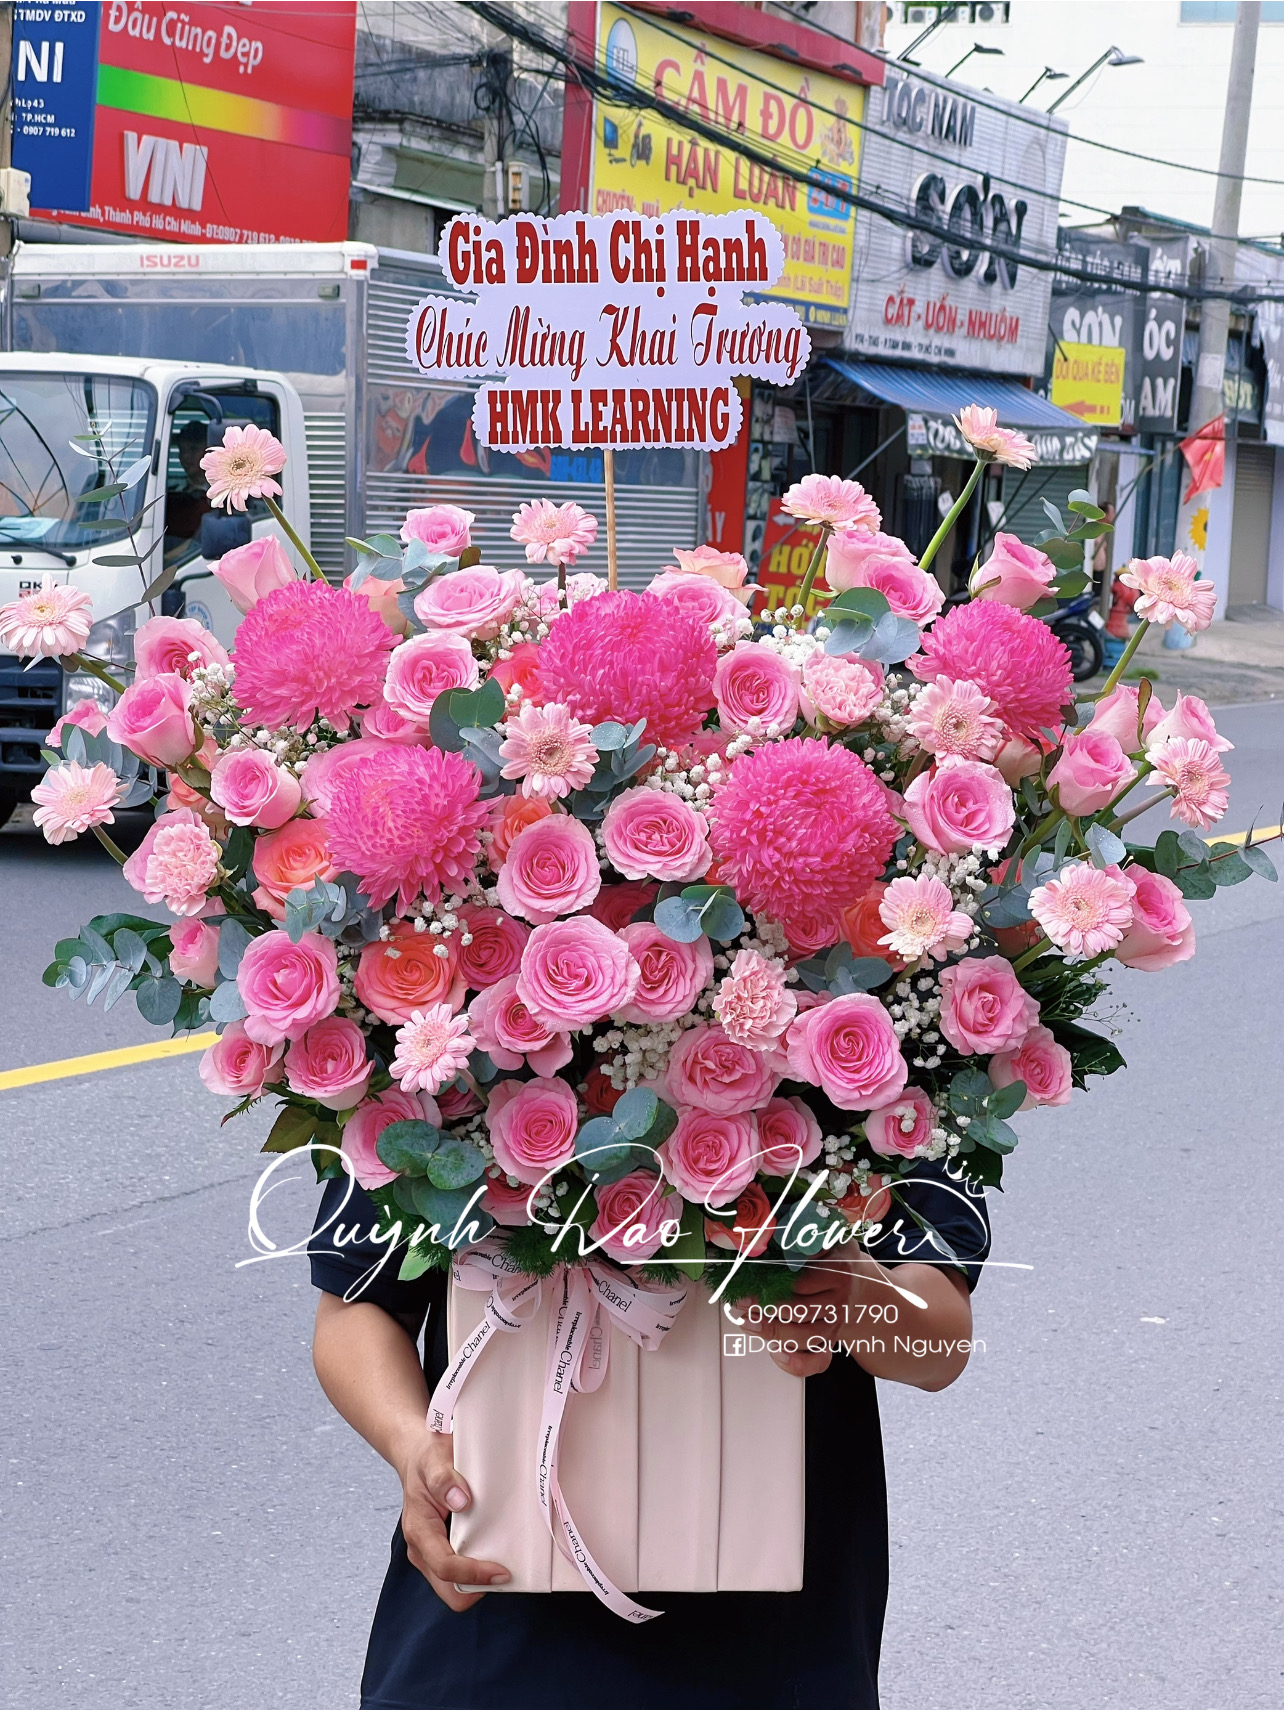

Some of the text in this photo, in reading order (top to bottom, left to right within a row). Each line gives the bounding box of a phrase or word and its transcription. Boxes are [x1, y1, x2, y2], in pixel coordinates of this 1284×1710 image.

[161, 11, 217, 64] Cũng
[220, 25, 263, 74] Đẹp
[760, 76, 815, 150] ĐỒ
[928, 90, 976, 147] NAM
[123, 130, 208, 211] VINI
[104, 205, 132, 225] Thành
[133, 210, 151, 228] Phố
[905, 172, 1028, 290] SƠN
[140, 254, 200, 269] ISUZU
[448, 220, 506, 286] Gia
[515, 220, 599, 285] Đình
[609, 219, 667, 299] Chị
[676, 219, 769, 299] Hạnh
[415, 302, 803, 382] Chúc Mừng Khai Trương
[487, 387, 730, 445] HMK LEARNING
[462, 1320, 492, 1360] Chanel
[553, 1349, 573, 1395] Chanel
